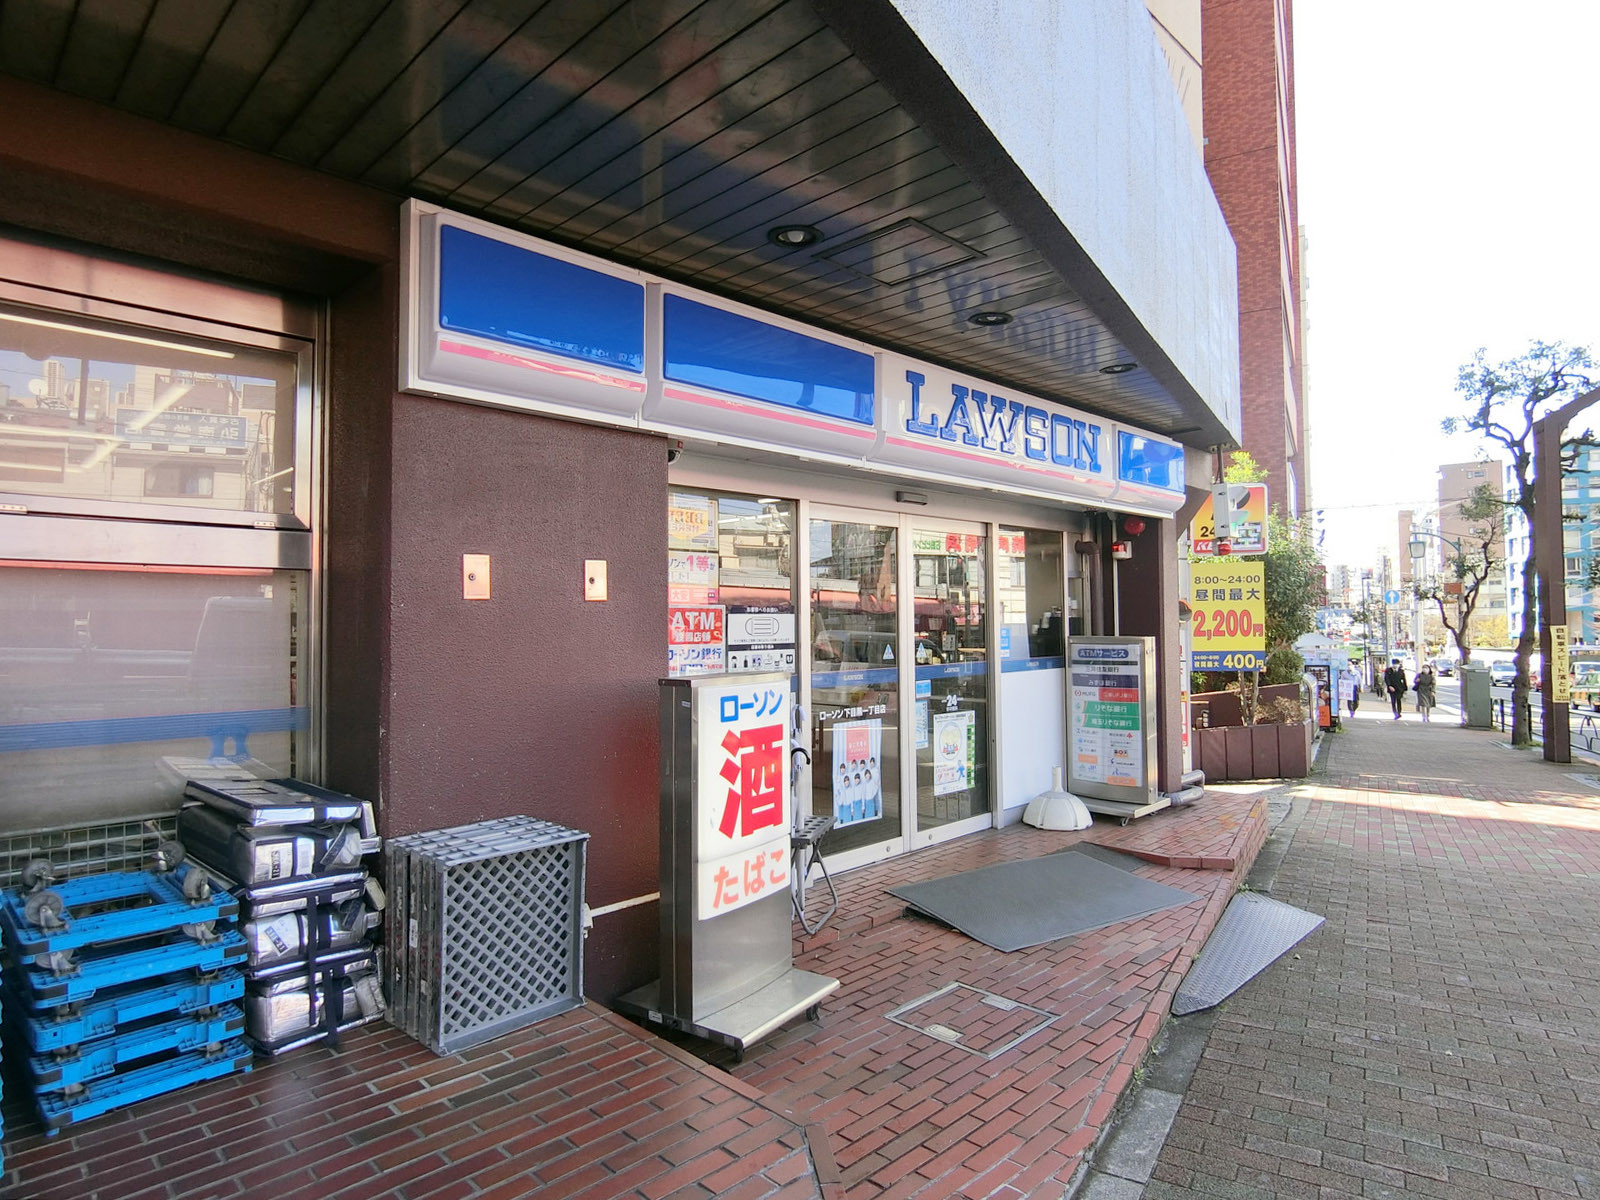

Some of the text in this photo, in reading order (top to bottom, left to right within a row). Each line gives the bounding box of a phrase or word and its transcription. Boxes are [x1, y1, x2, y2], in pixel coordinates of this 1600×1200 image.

[905, 370, 1101, 473] LAWSON
[1195, 588, 1260, 602] 昼間最大
[671, 611, 715, 630] ATM
[1193, 609, 1263, 640] 2,200円
[1079, 650, 1126, 658] ATMサービス
[1223, 653, 1264, 669] 400円
[720, 689, 783, 722] ローソン
[1094, 704, 1127, 713] りそな銀行
[718, 723, 783, 839] 酒
[713, 849, 786, 909] たばこ
